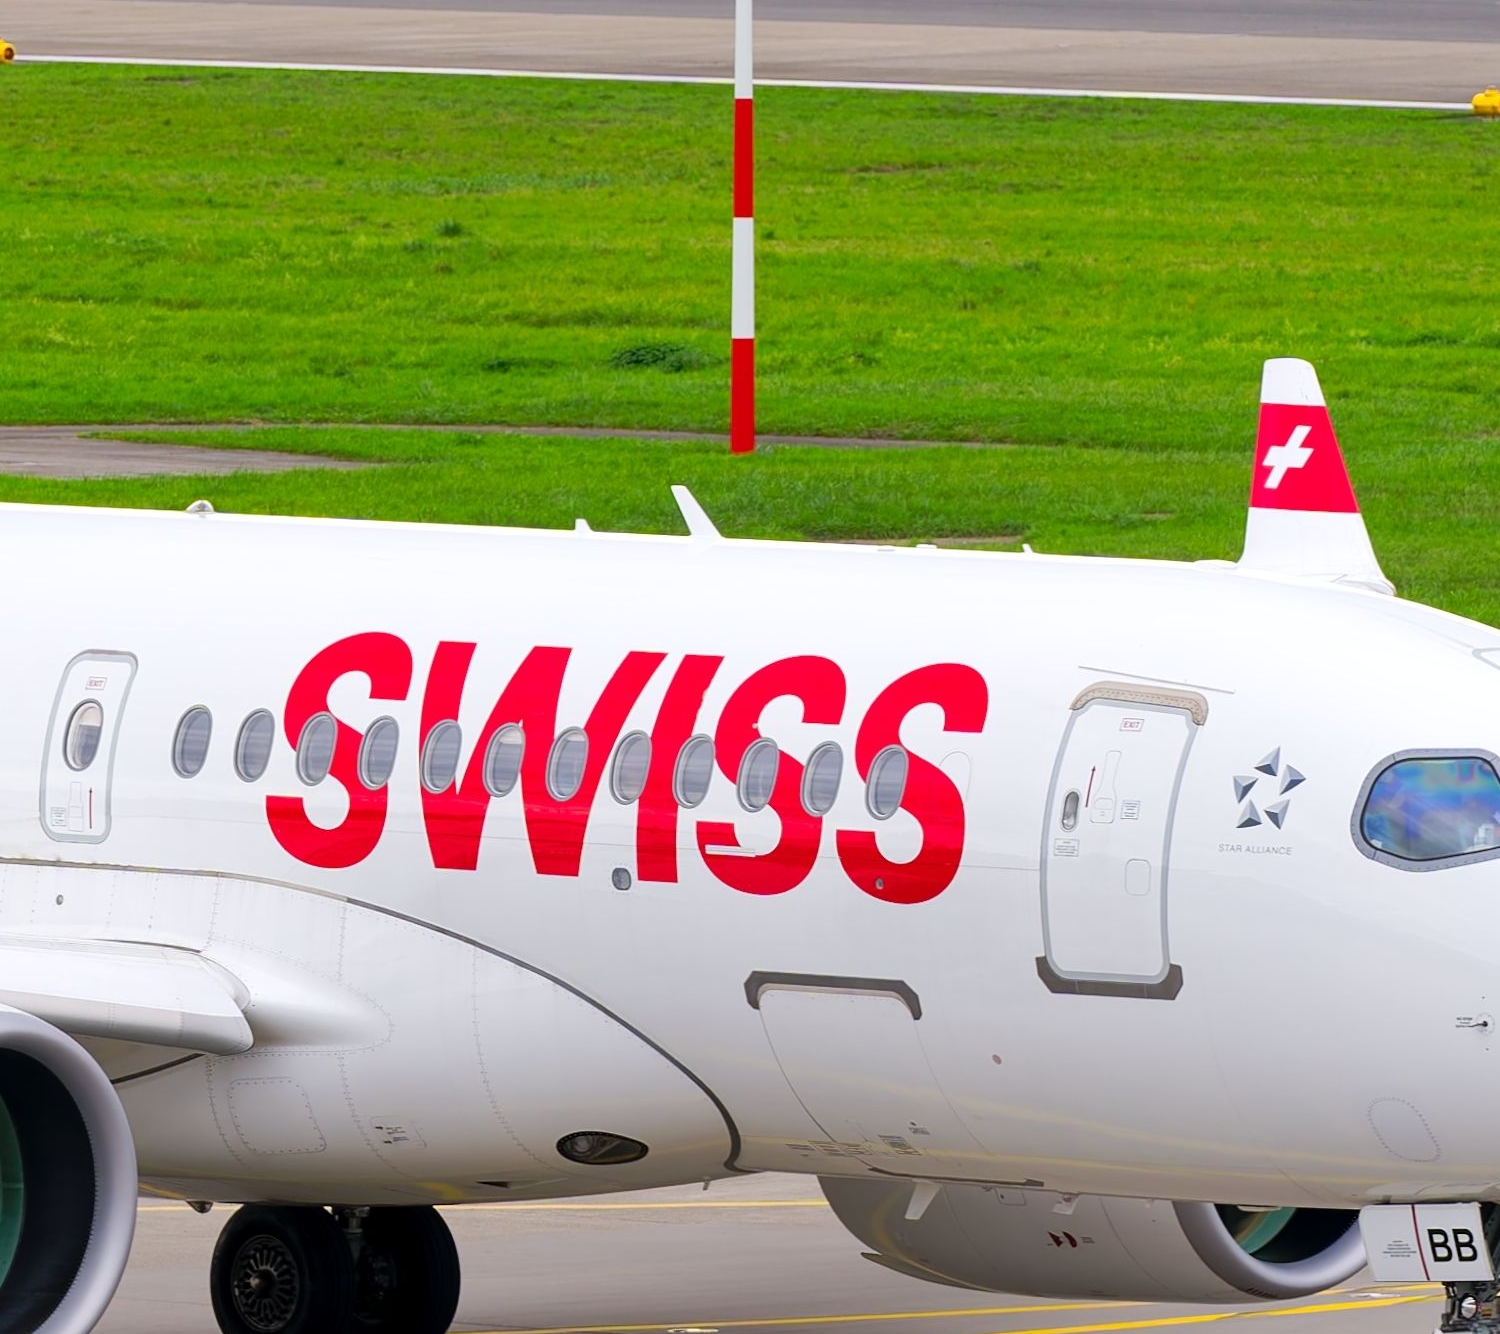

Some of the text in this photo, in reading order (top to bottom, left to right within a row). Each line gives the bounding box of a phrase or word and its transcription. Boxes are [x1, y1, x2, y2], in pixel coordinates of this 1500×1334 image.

[1123, 720, 1142, 729] EXIT
[266, 631, 989, 905] SWISS
[1218, 843, 1294, 856] STAR ALLIANCE
[1427, 1228, 1478, 1263] BB
